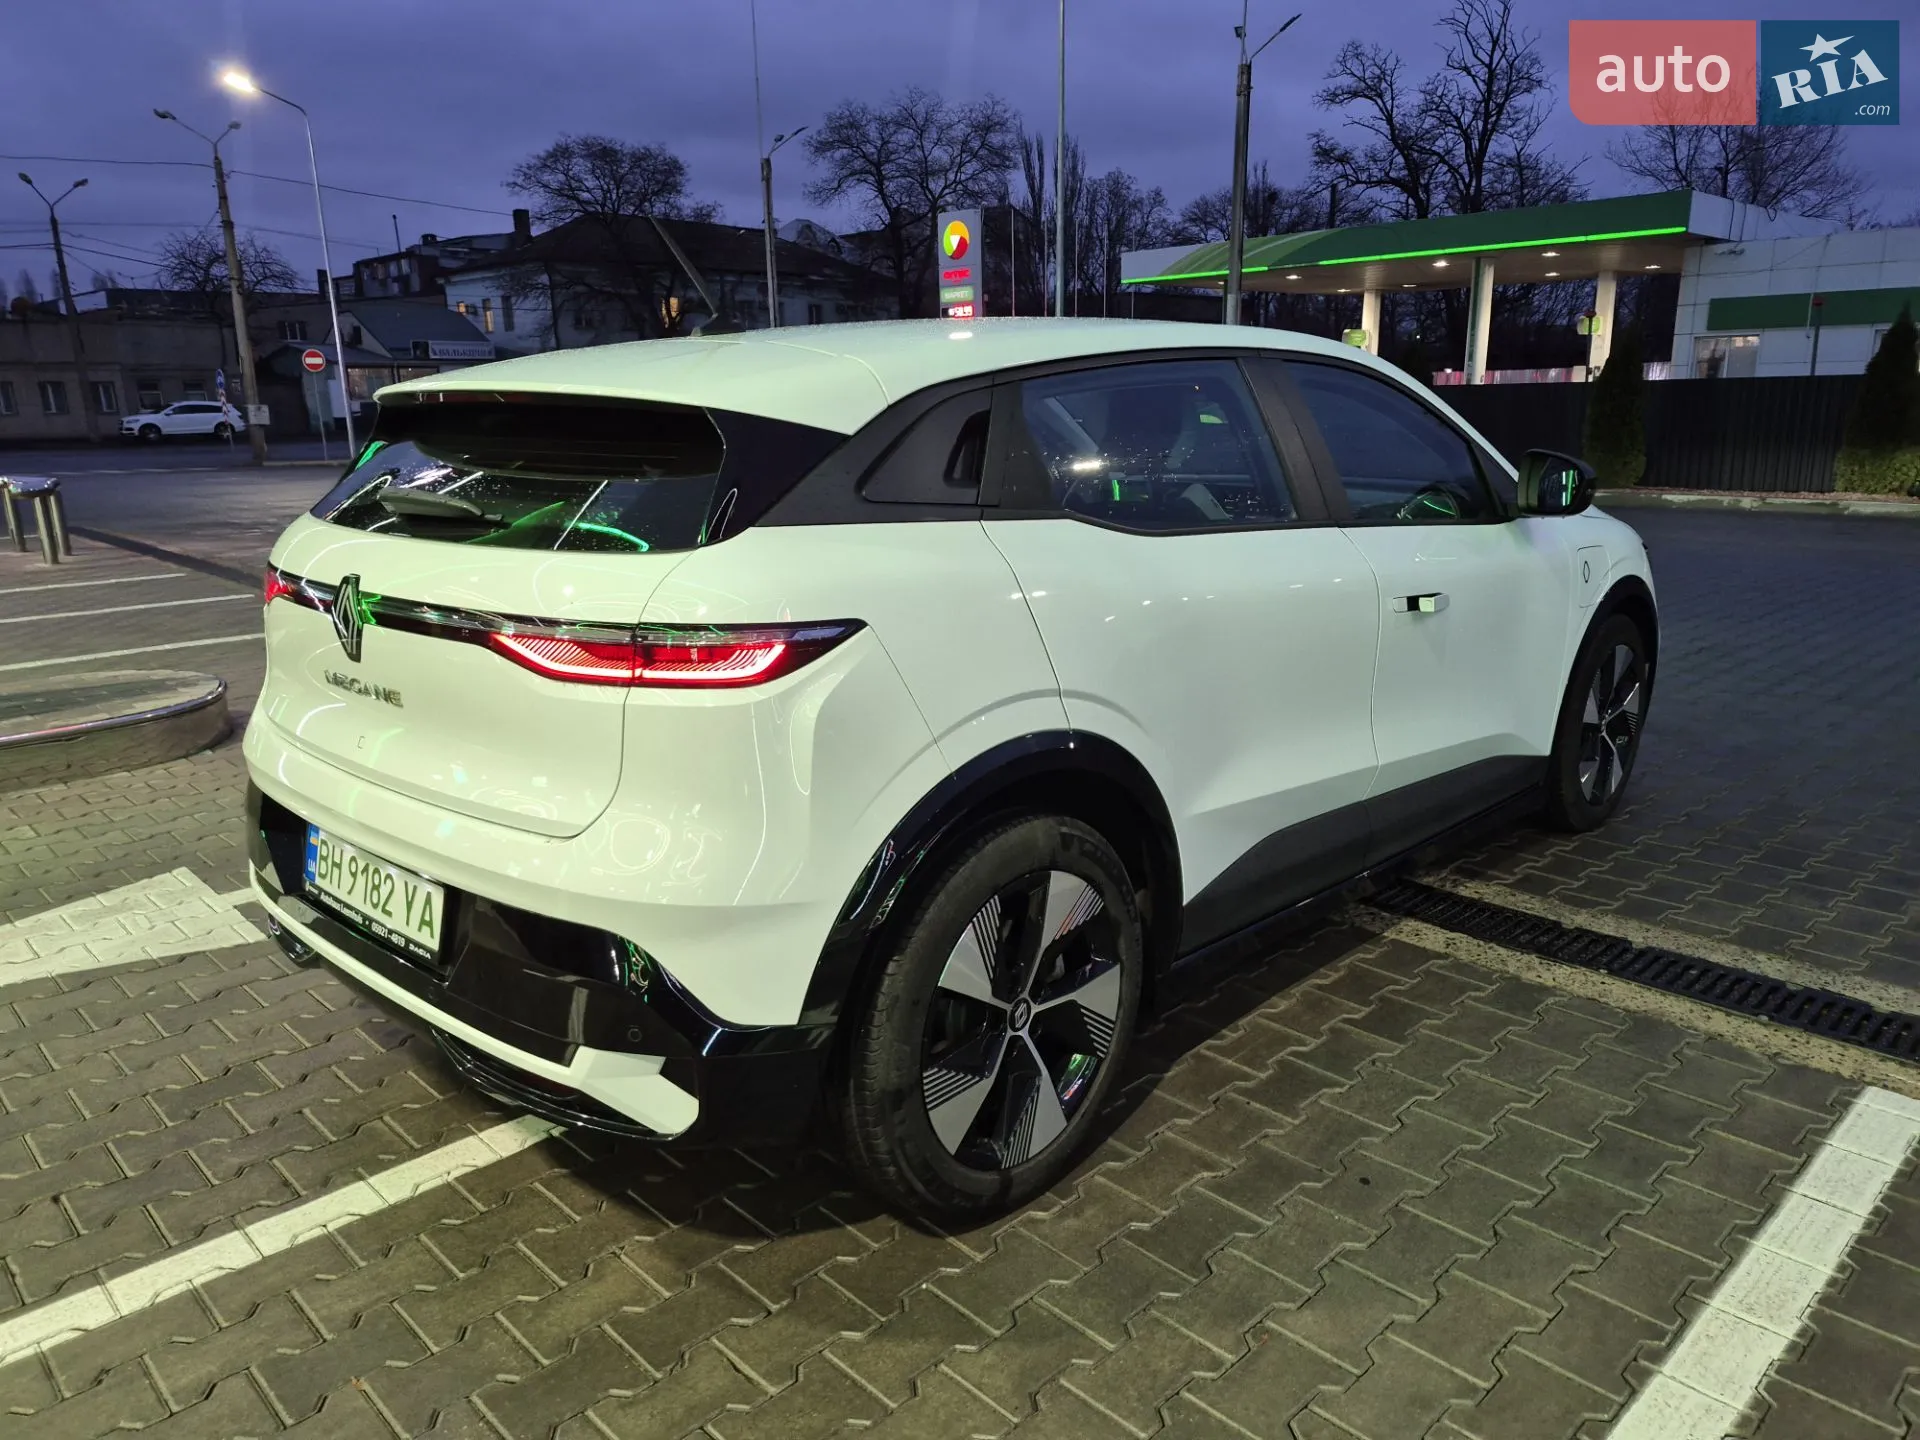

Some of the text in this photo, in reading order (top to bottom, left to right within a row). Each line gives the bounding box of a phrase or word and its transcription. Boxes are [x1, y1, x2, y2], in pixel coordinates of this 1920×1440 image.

[323, 669, 404, 709] MEGANE
[318, 838, 435, 940] BH 9182 YA
[408, 943, 432, 960] DACIA
